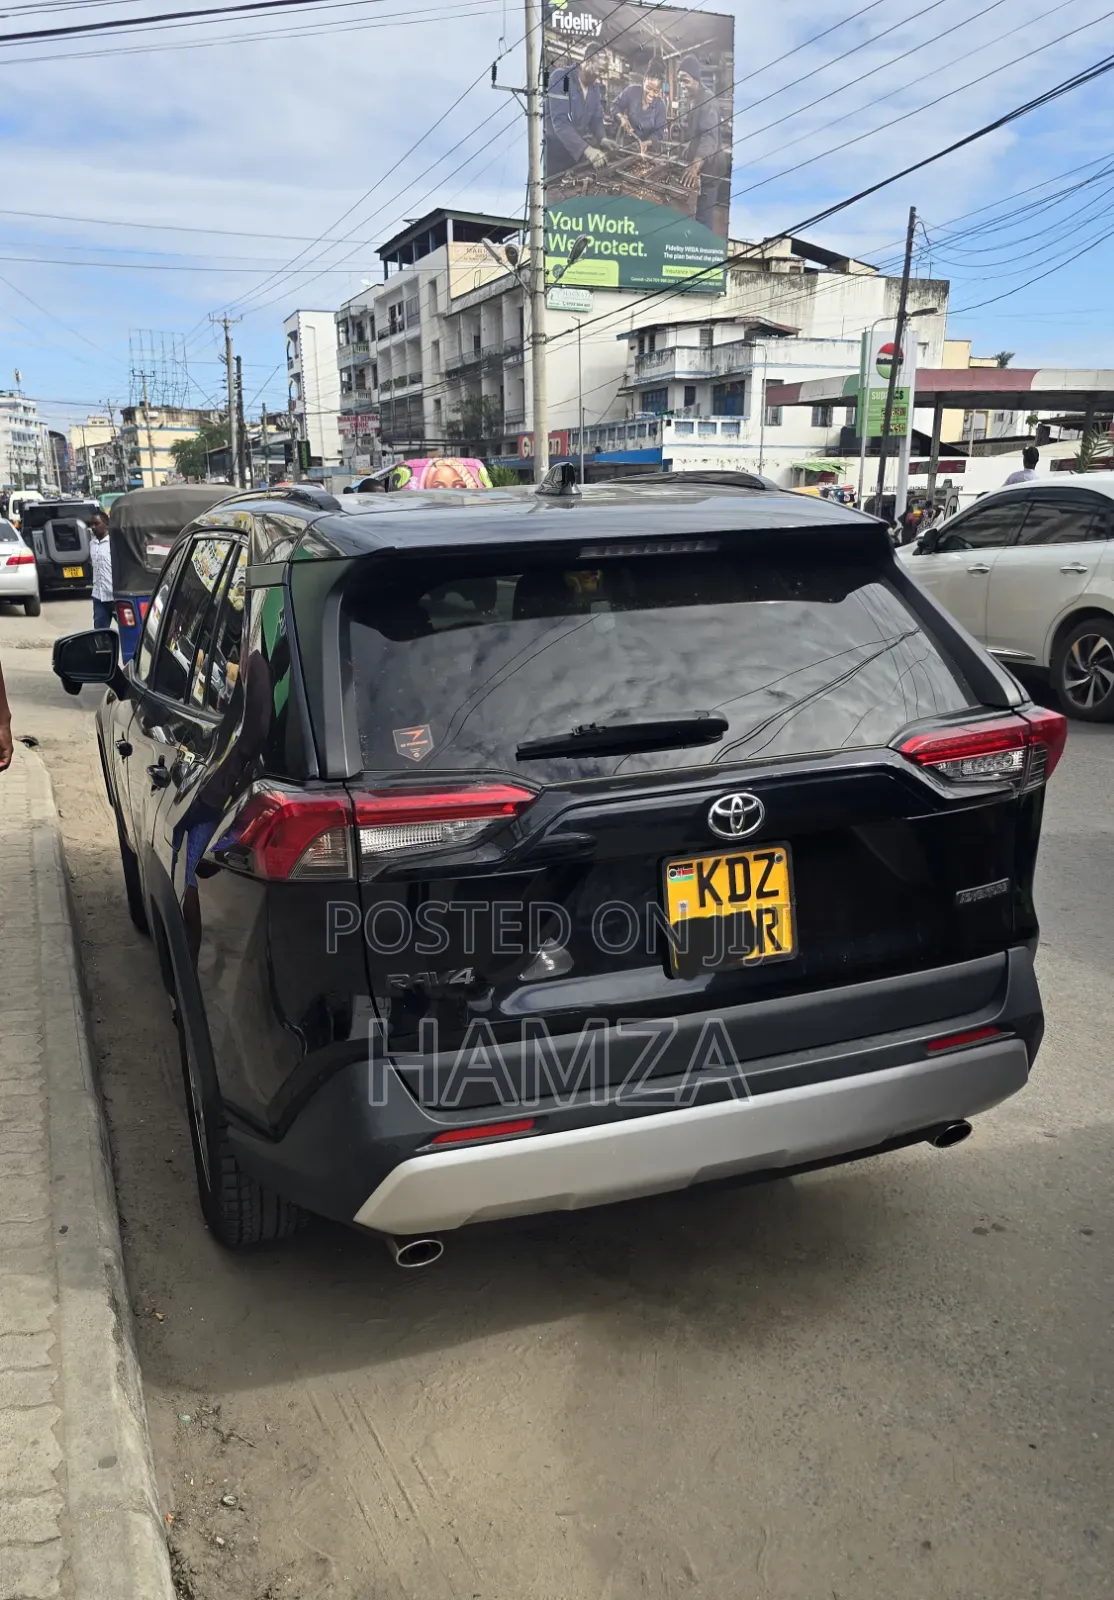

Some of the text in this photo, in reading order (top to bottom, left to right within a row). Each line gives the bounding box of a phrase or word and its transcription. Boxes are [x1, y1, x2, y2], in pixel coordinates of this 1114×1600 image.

[552, 10, 602, 36] Fidelity
[549, 211, 639, 235] You Work.
[548, 233, 647, 257] We Protect.
[674, 253, 685, 261] plan
[697, 852, 779, 908] KDZ
[386, 967, 475, 992] RAV4
